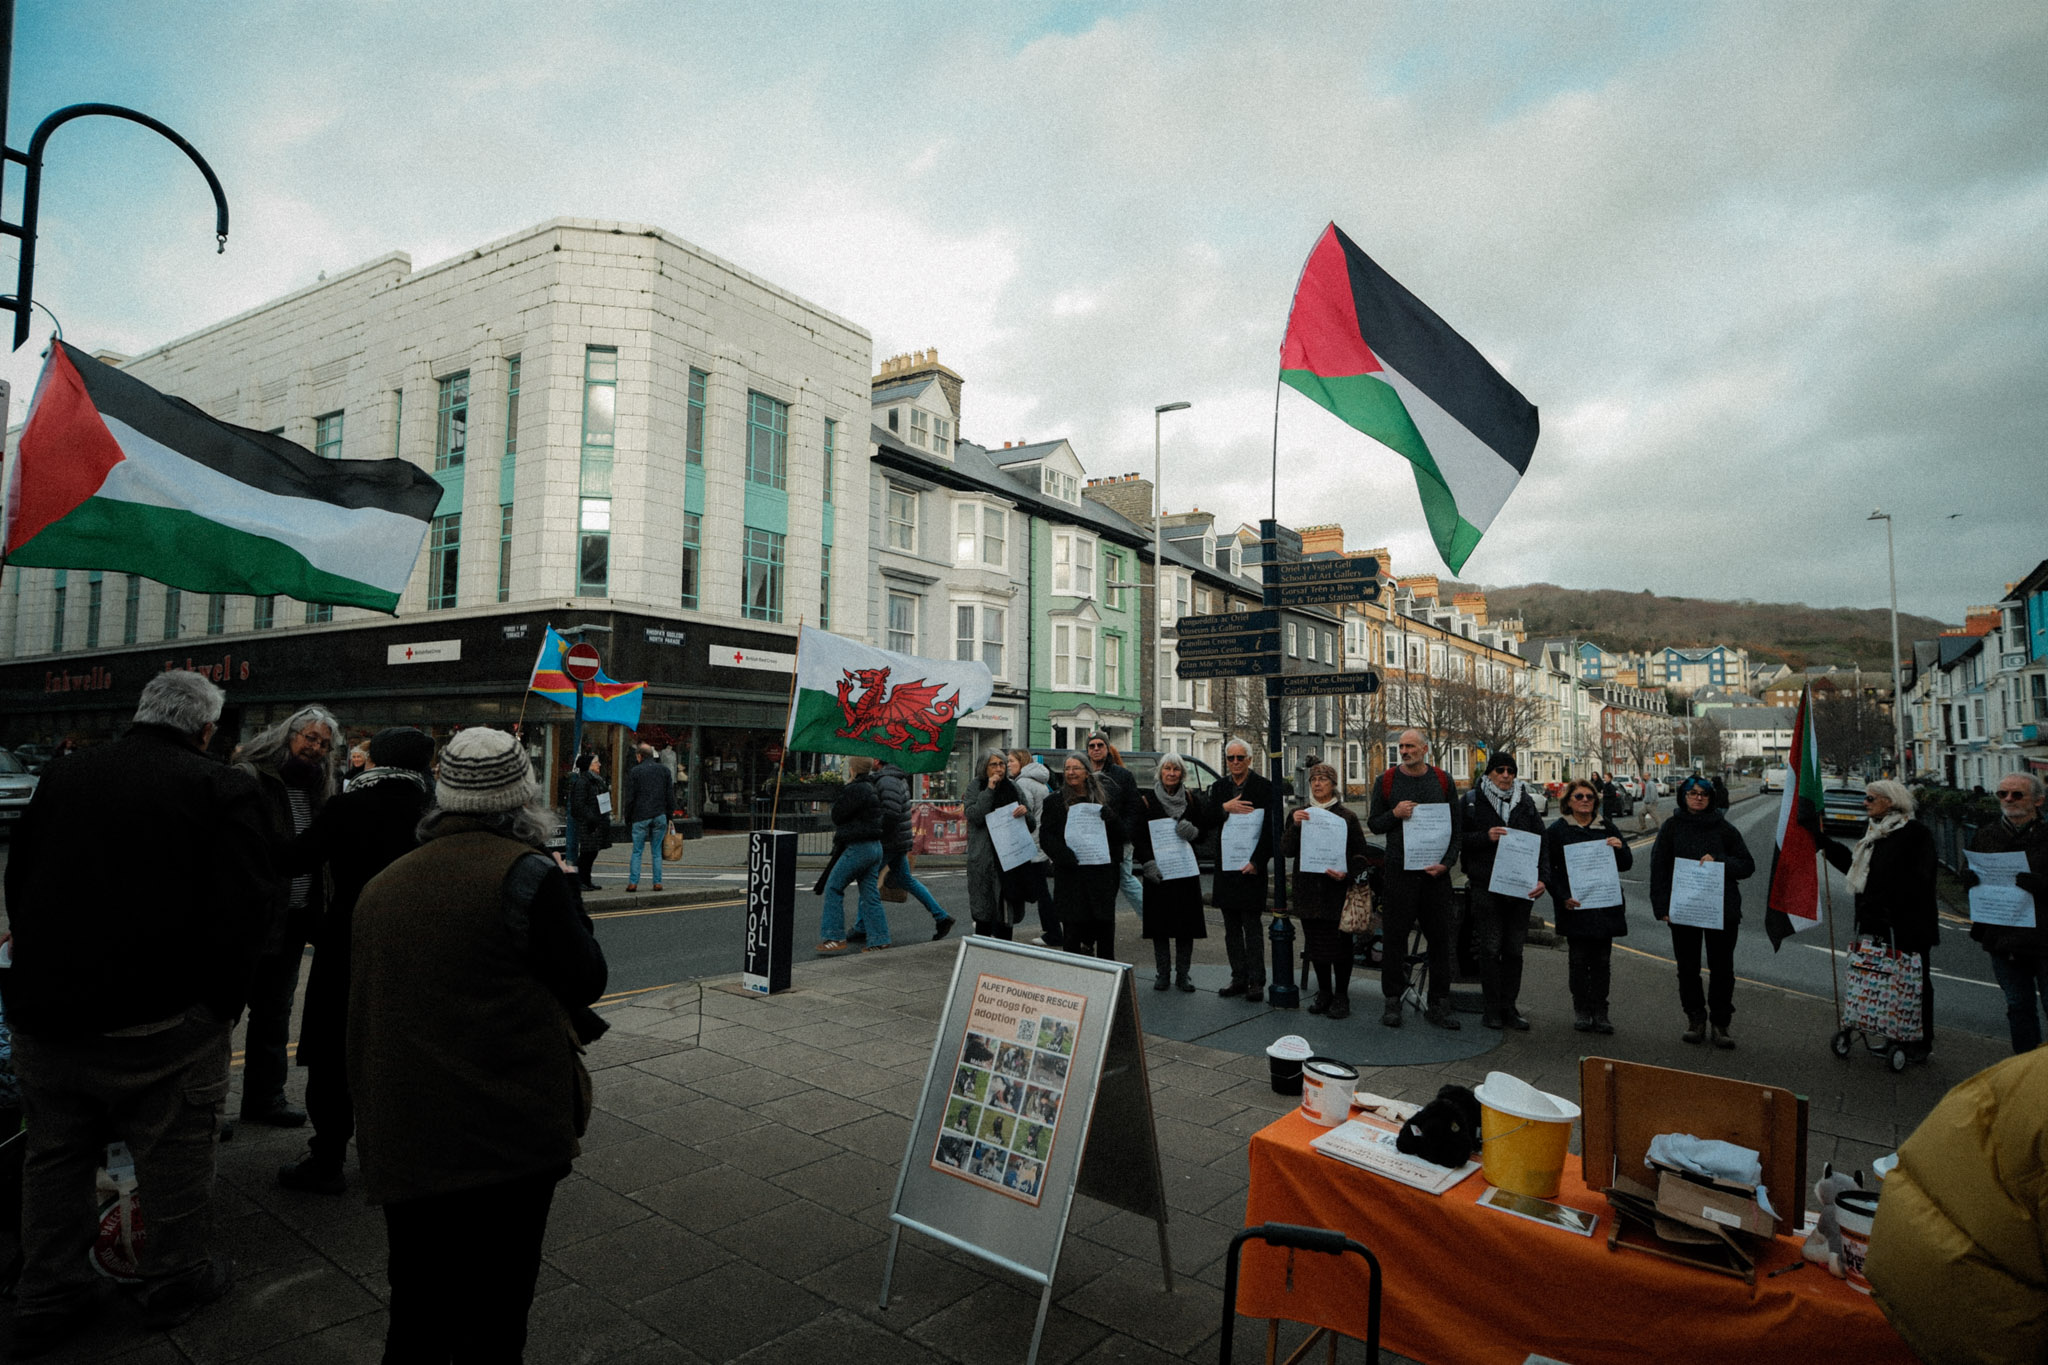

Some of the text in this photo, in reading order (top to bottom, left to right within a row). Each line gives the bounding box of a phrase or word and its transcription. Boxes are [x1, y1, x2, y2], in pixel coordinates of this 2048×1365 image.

[1280, 564, 1300, 574] Oriel
[1312, 561, 1332, 571] Ysgol
[1335, 559, 1352, 568] Gelf
[1281, 569, 1362, 583] School of Art Gallery
[1281, 586, 1308, 595] Gorsaf
[1337, 583, 1354, 591] Bws
[1281, 592, 1360, 605] Bus & Train Stations
[1230, 613, 1249, 622] Oriel
[1180, 623, 1244, 635] Museum & Gallery
[1180, 636, 1236, 648] Canolfan Croeso
[1180, 646, 1244, 657] Information Centre
[1180, 660, 1198, 669] Glan
[1331, 674, 1365, 684] Chwarae
[758, 842, 771, 948] LOCAL
[747, 833, 761, 974] SUPPORT
[981, 981, 1080, 1012] ALPET POUNDIES RESCUE
[978, 993, 1038, 1016] Our dogs for
[974, 1008, 1016, 1026] adoption
